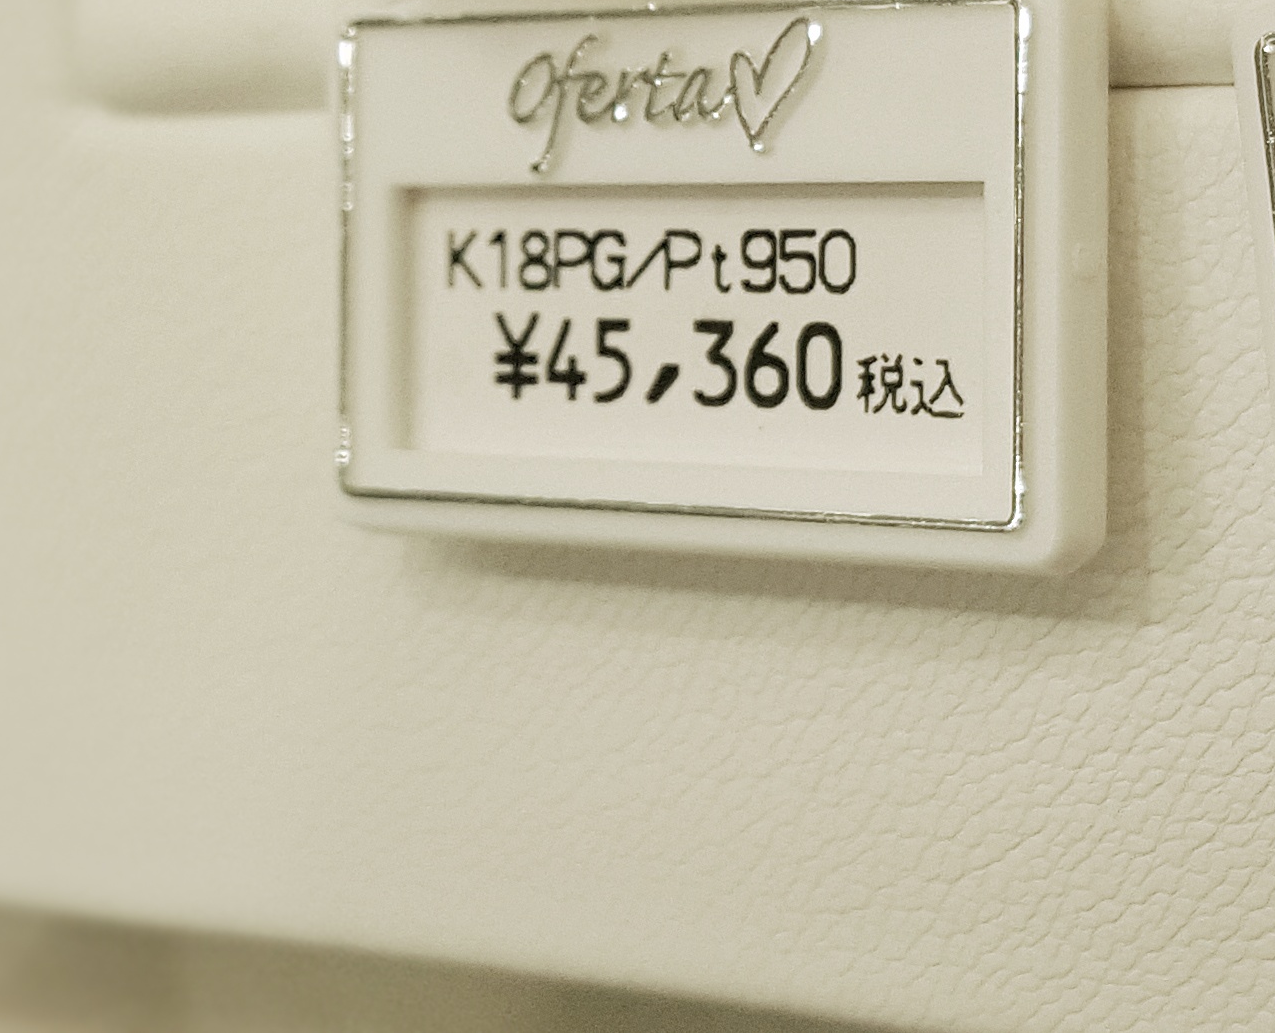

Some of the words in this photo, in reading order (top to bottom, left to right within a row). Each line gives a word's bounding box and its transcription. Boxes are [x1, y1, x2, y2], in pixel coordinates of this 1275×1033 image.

[446, 227, 858, 295] K18PG/Pt950
[493, 311, 844, 411] ¥45,360
[856, 353, 965, 419] 税込
